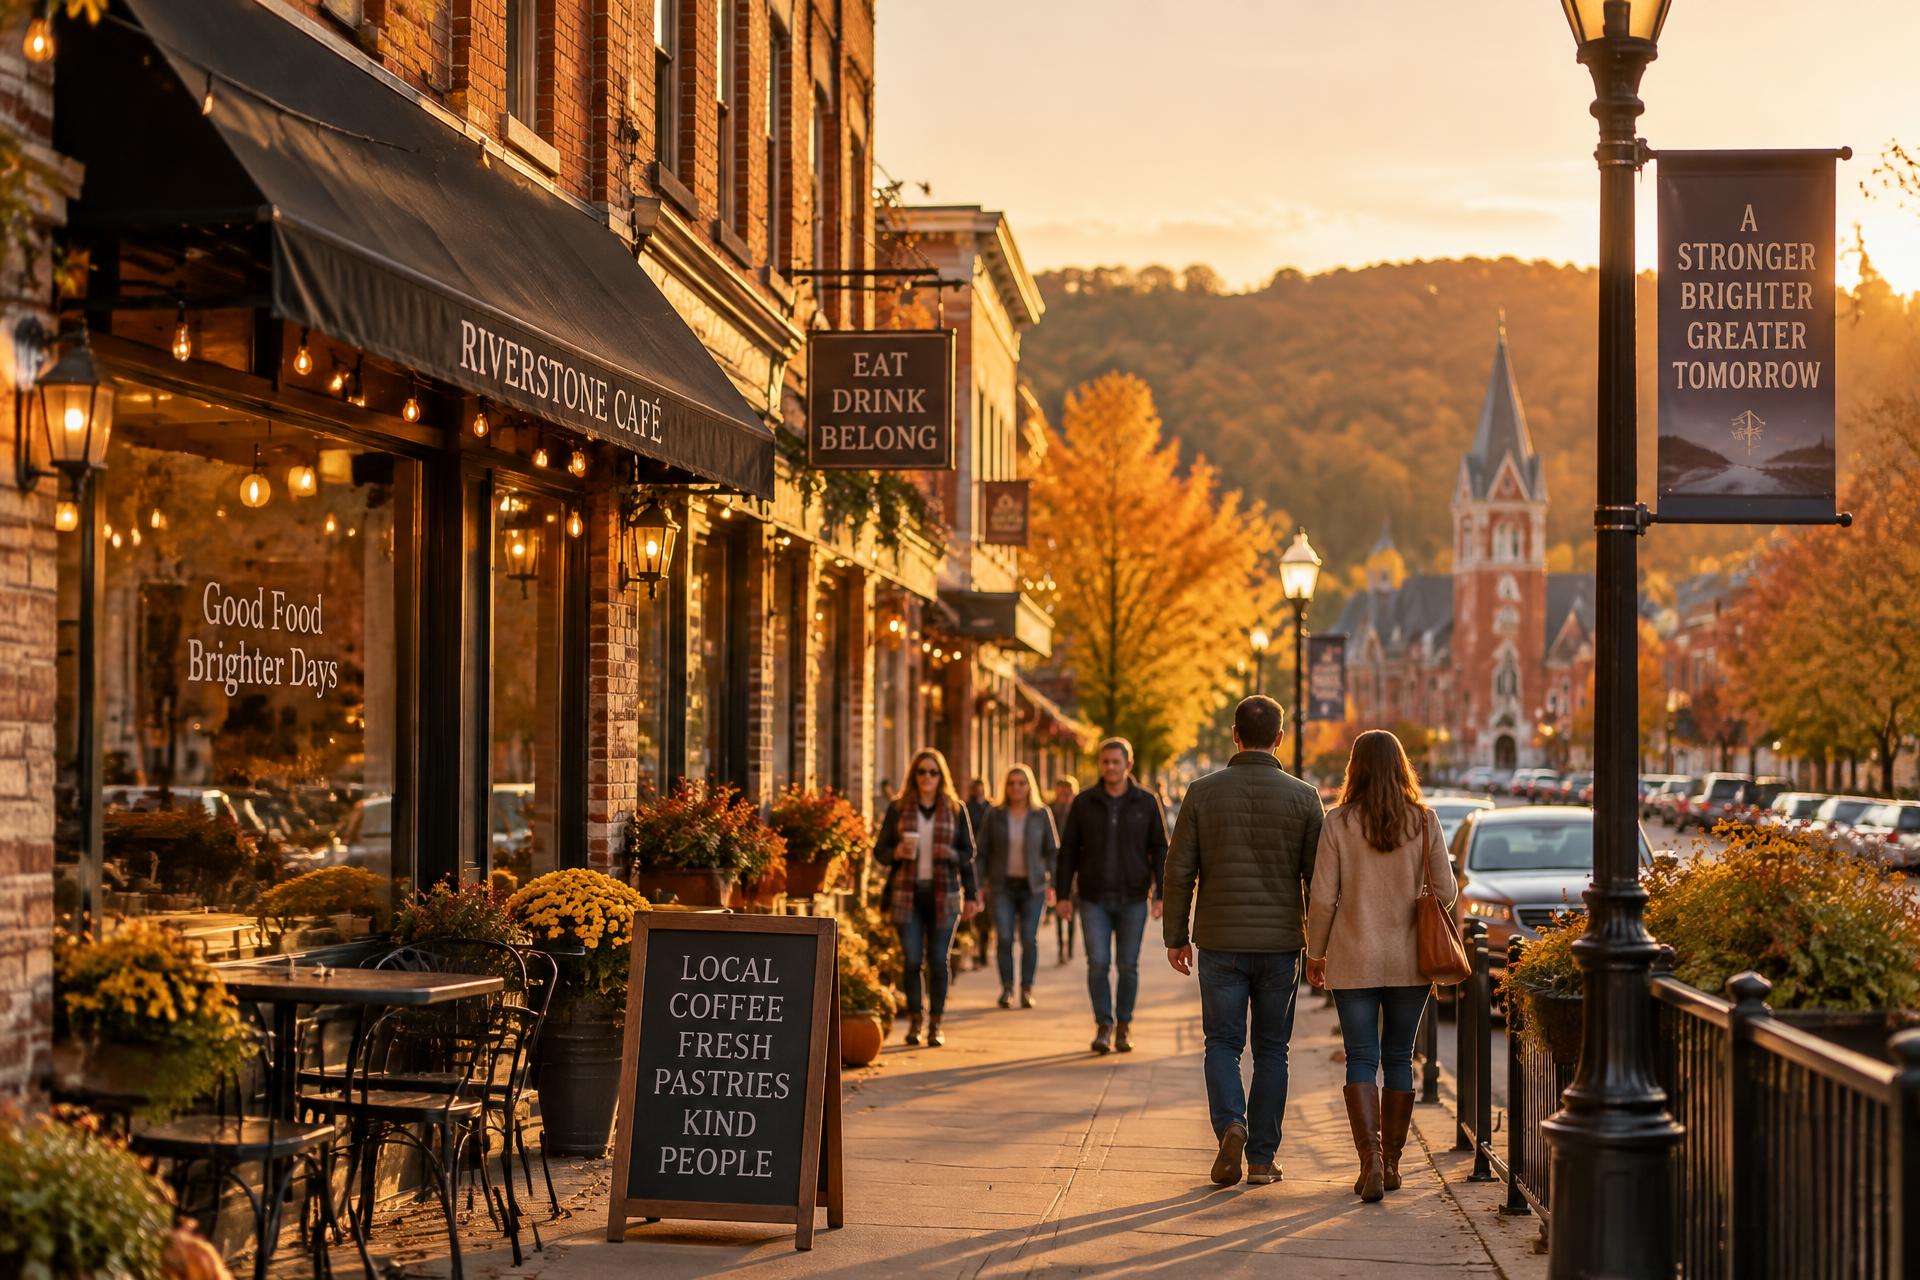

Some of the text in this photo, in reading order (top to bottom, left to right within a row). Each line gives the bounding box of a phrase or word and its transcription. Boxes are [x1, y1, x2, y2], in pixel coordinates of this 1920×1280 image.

[1740, 204, 1759, 232] A
[1677, 242, 1816, 271] STRONGER
[1680, 281, 1813, 310] BRIGHTER
[1687, 321, 1807, 350] GREATER
[853, 351, 908, 377] EAT
[1672, 360, 1821, 390] TOMORROW
[460, 319, 662, 444] RIVERSTONE CAFÉ
[832, 388, 927, 414] DRINK
[820, 425, 937, 450] BELONG
[203, 581, 323, 635] Good Food
[187, 639, 338, 699] Brighter Days
[680, 955, 780, 984] LOCAL
[669, 992, 784, 1023] COFFEE
[677, 1031, 773, 1061] FRESH
[653, 1068, 790, 1100] PASTRIES
[682, 1108, 756, 1138] KIND
[658, 1146, 773, 1178] PEOPLE
